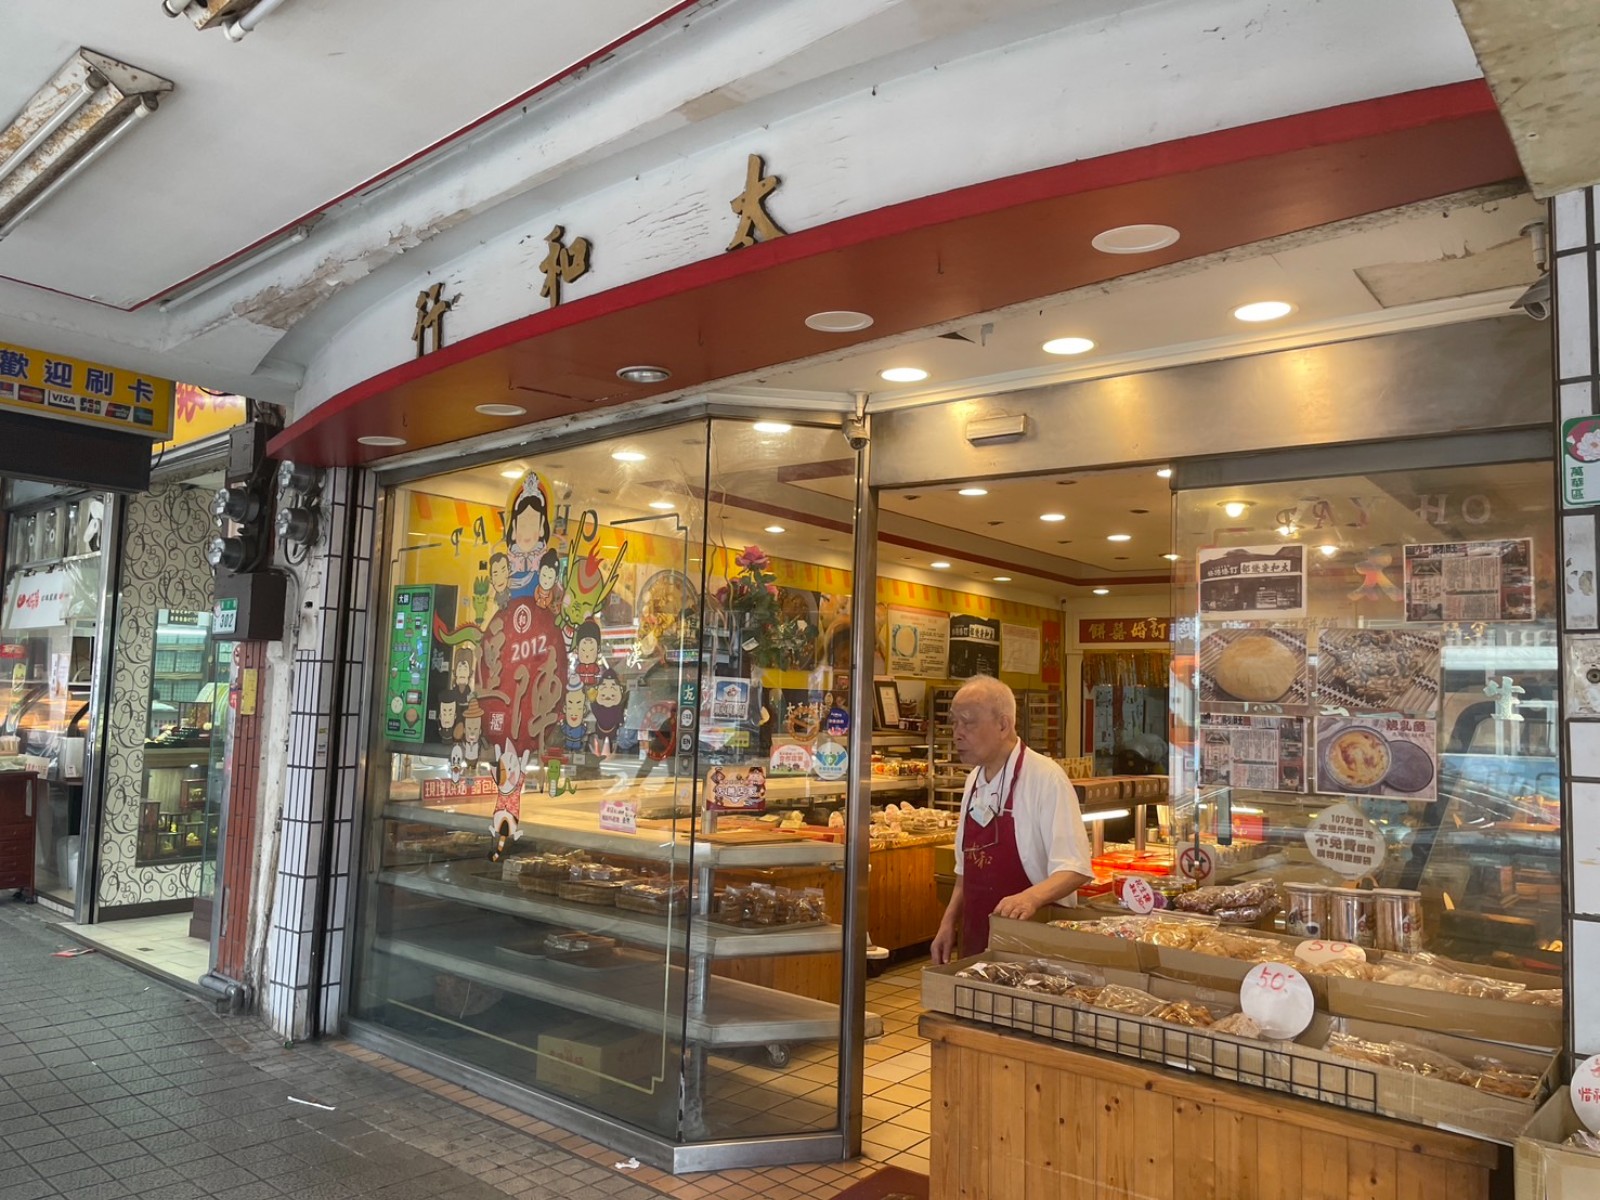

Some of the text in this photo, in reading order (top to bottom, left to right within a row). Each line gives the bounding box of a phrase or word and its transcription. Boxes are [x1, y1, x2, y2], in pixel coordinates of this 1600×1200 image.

[0, 349, 154, 403] 歡迎刷卡
[52, 393, 76, 406] VISA
[1570, 466, 1584, 499] 萬華區
[219, 613, 234, 628] 302
[511, 636, 548, 663] 2012
